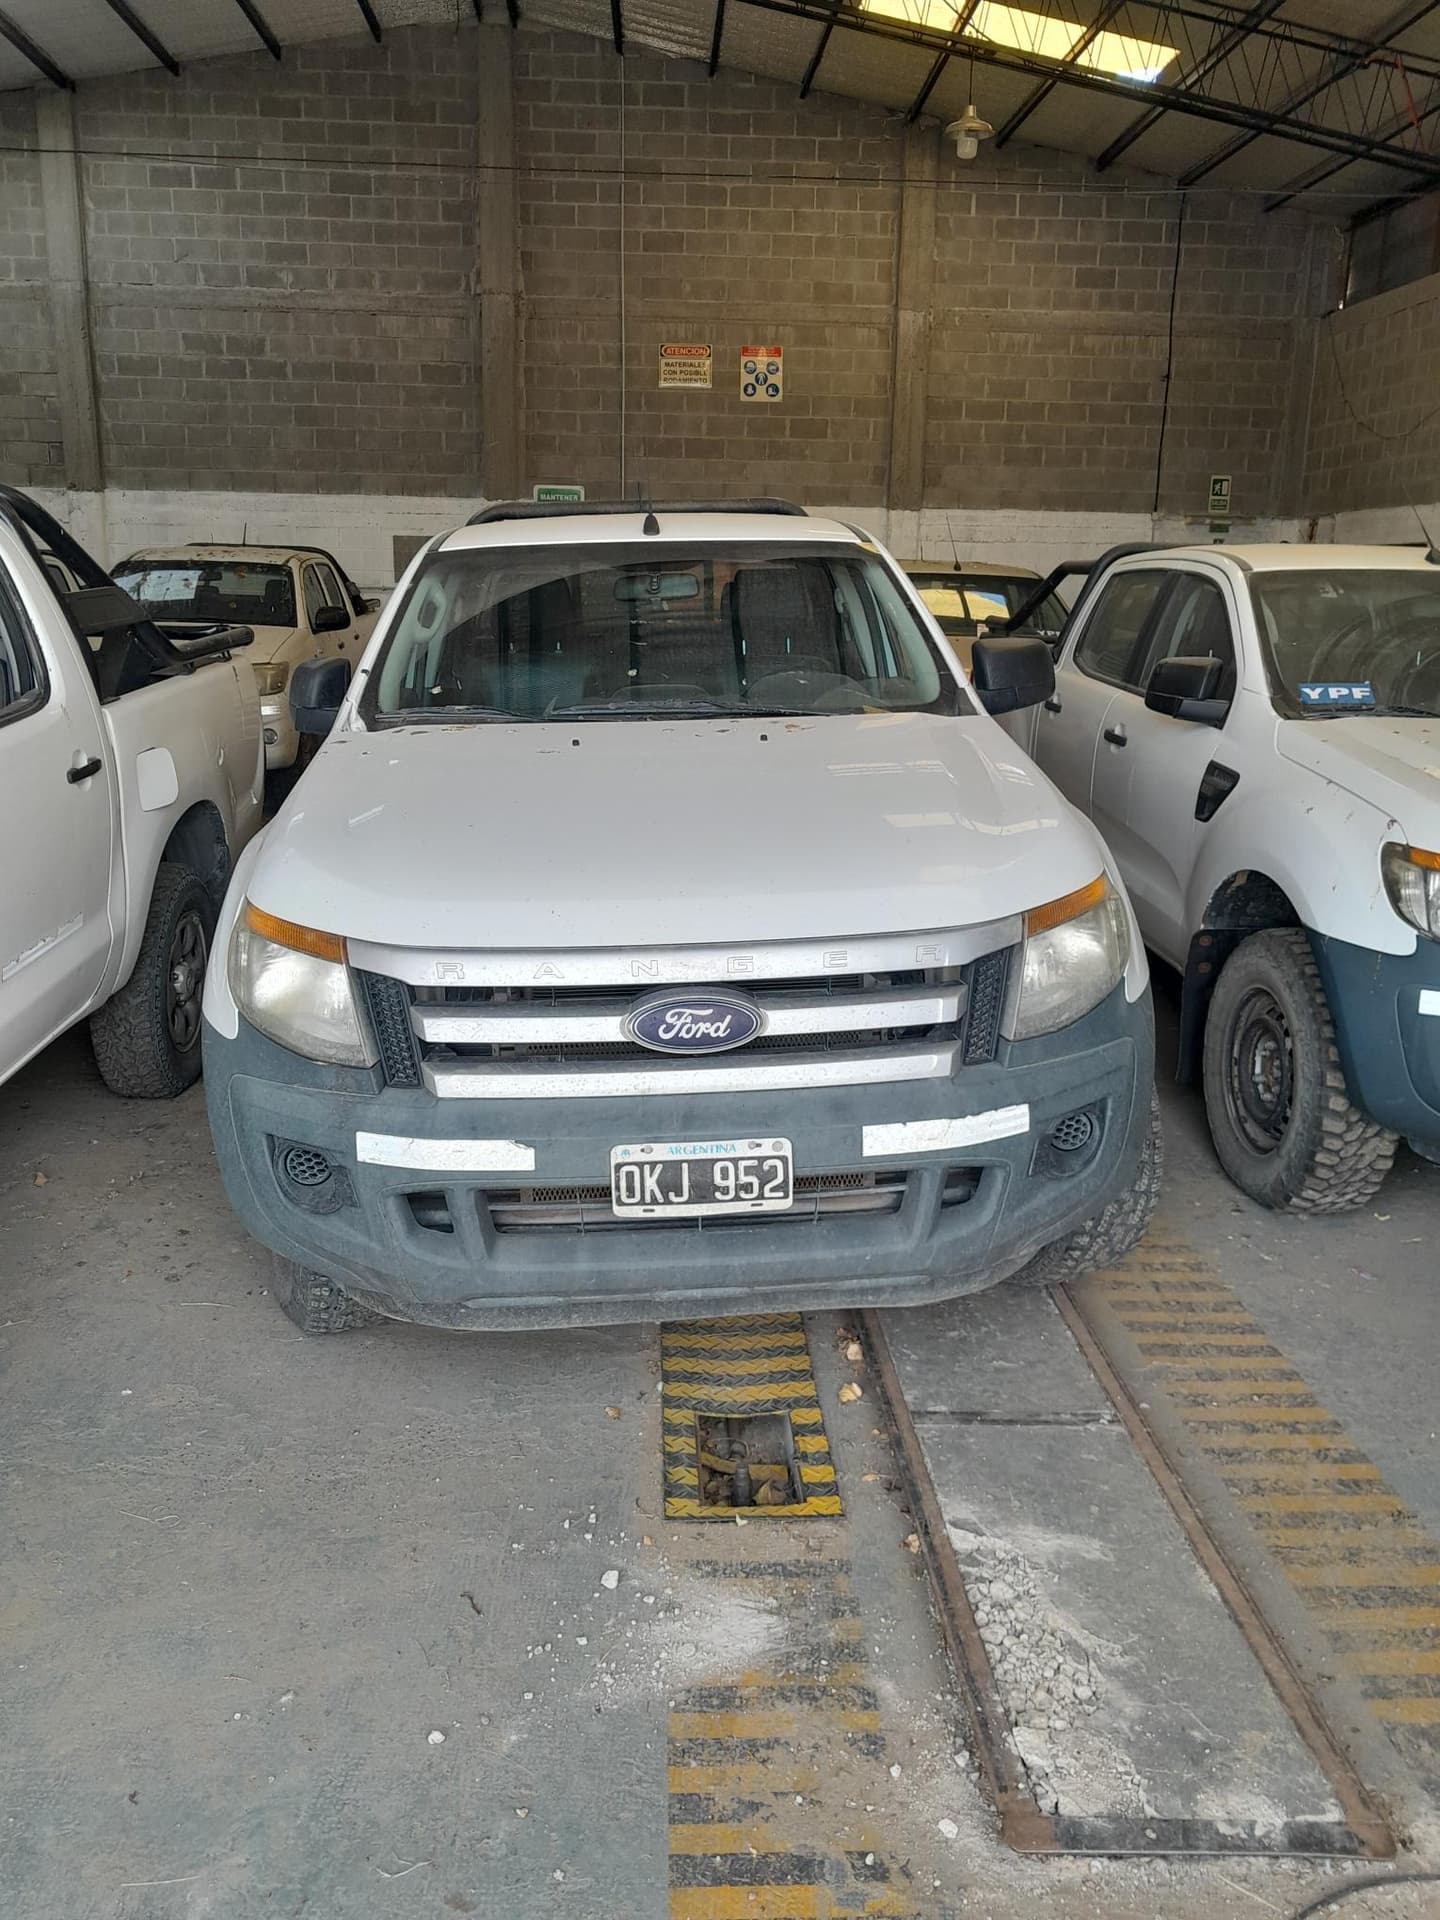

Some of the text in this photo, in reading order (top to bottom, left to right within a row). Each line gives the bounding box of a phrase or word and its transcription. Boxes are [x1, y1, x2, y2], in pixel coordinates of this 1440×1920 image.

[666, 347, 706, 355] ATENCION
[1301, 687, 1371, 699] YPF
[435, 944, 943, 979] RANGER
[658, 1009, 732, 1039] Ford
[667, 1143, 737, 1156] ARGENTINA
[619, 1159, 785, 1204] OKJ 952
